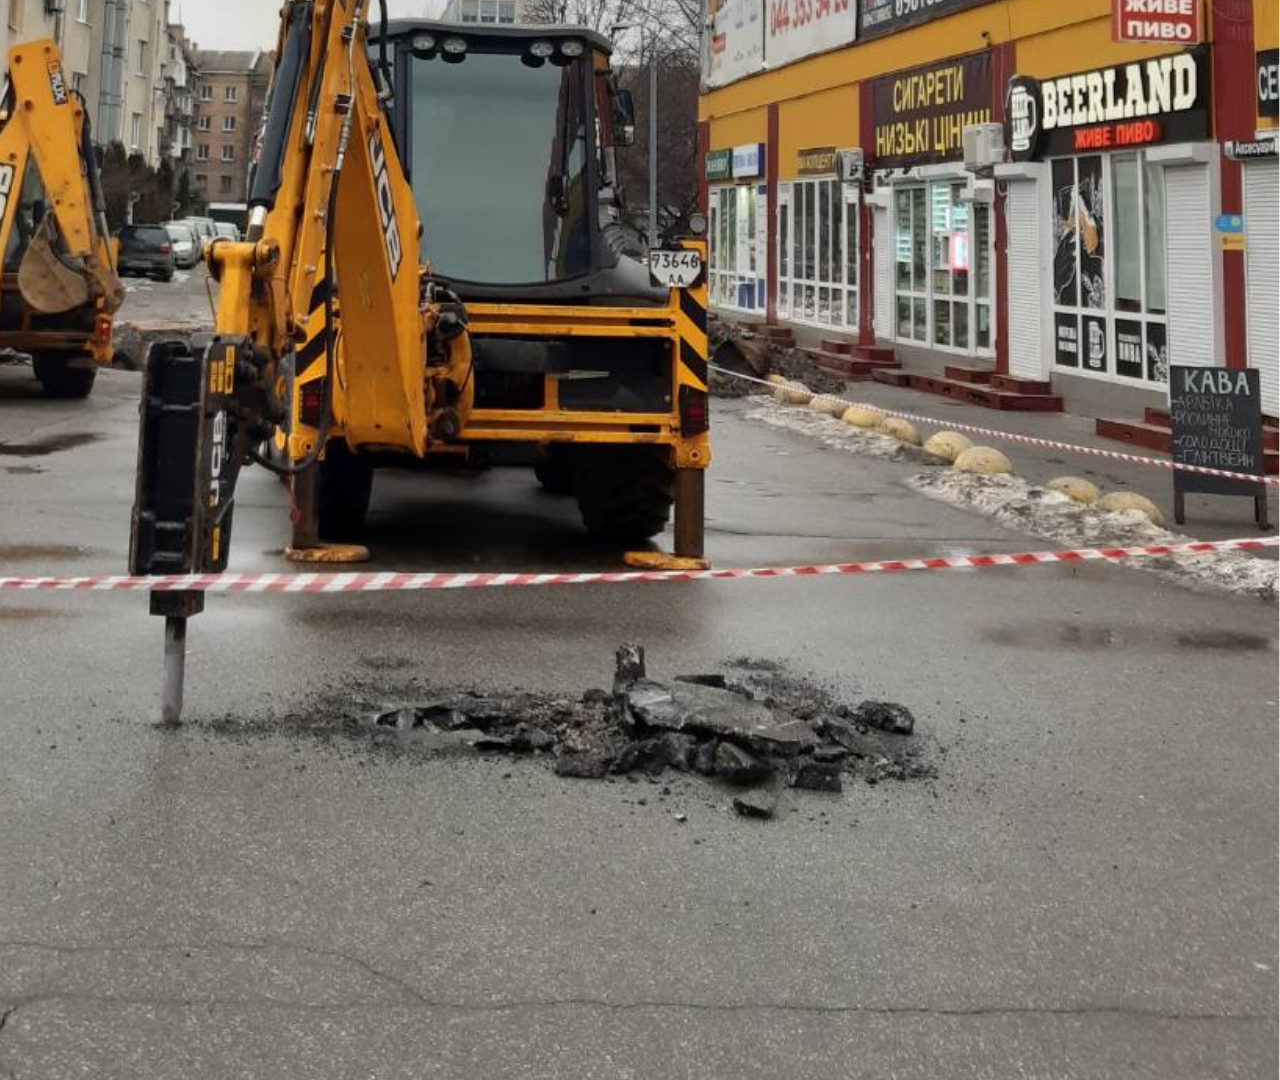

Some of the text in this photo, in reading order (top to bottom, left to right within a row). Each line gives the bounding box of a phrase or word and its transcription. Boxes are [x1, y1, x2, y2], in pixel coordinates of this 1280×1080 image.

[1127, 20, 1192, 39] ПИВО
[893, 64, 964, 112] СИГАРЕТИ
[1042, 53, 1197, 130] BEERLAND
[876, 118, 930, 158] НИЗЬКІ
[1075, 121, 1154, 149] ЖИВЕ ПИВО
[369, 135, 402, 277] JCB
[653, 253, 698, 268] 73646
[1185, 370, 1250, 395] КАВА
[210, 410, 223, 506] JCB
